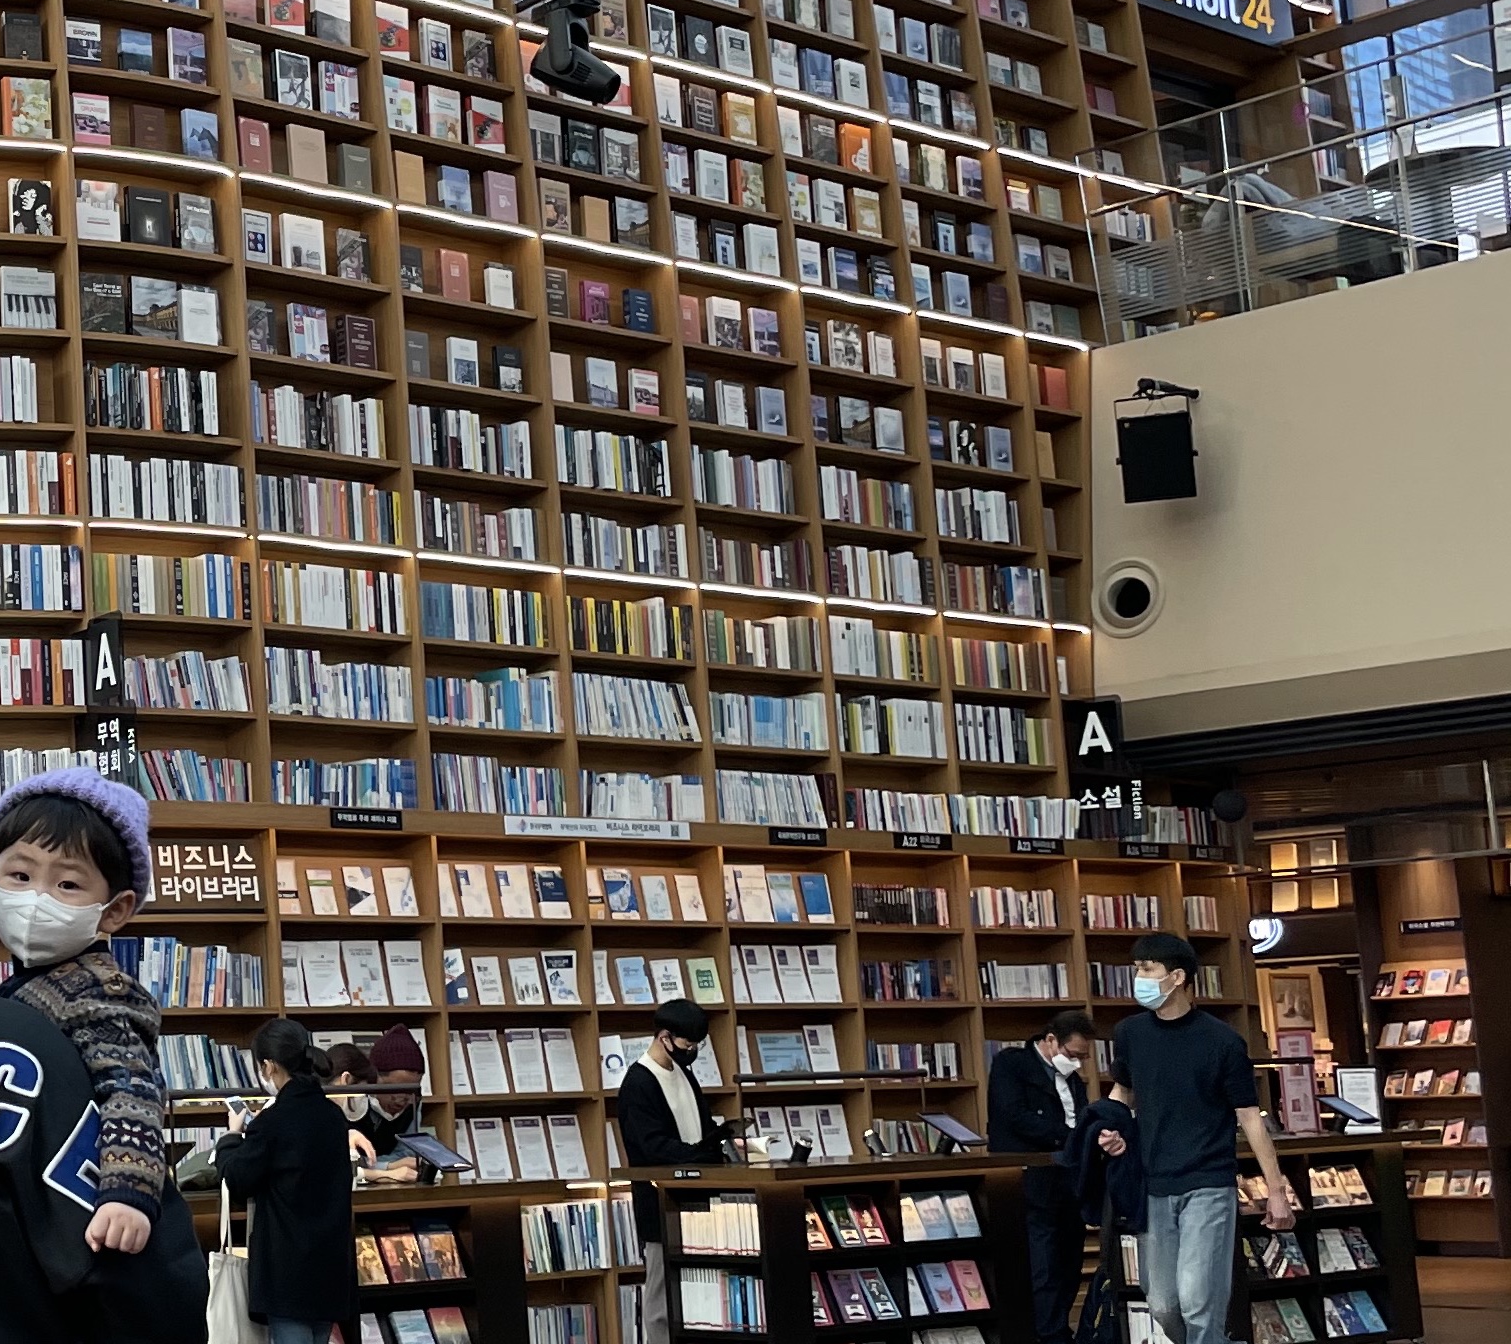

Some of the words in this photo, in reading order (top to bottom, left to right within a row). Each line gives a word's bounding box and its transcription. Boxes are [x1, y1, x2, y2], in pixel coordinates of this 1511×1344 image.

[95, 632, 117, 690] A
[97, 718, 121, 746] 무역
[127, 727, 135, 764] KITA
[1079, 711, 1113, 756] A
[98, 749, 121, 775] 협회
[1080, 784, 1122, 810] 소설
[1131, 779, 1142, 821] Fiction
[902, 835, 918, 848] A22
[157, 844, 257, 875] 비즈니스
[160, 875, 261, 903] 라이브러리
